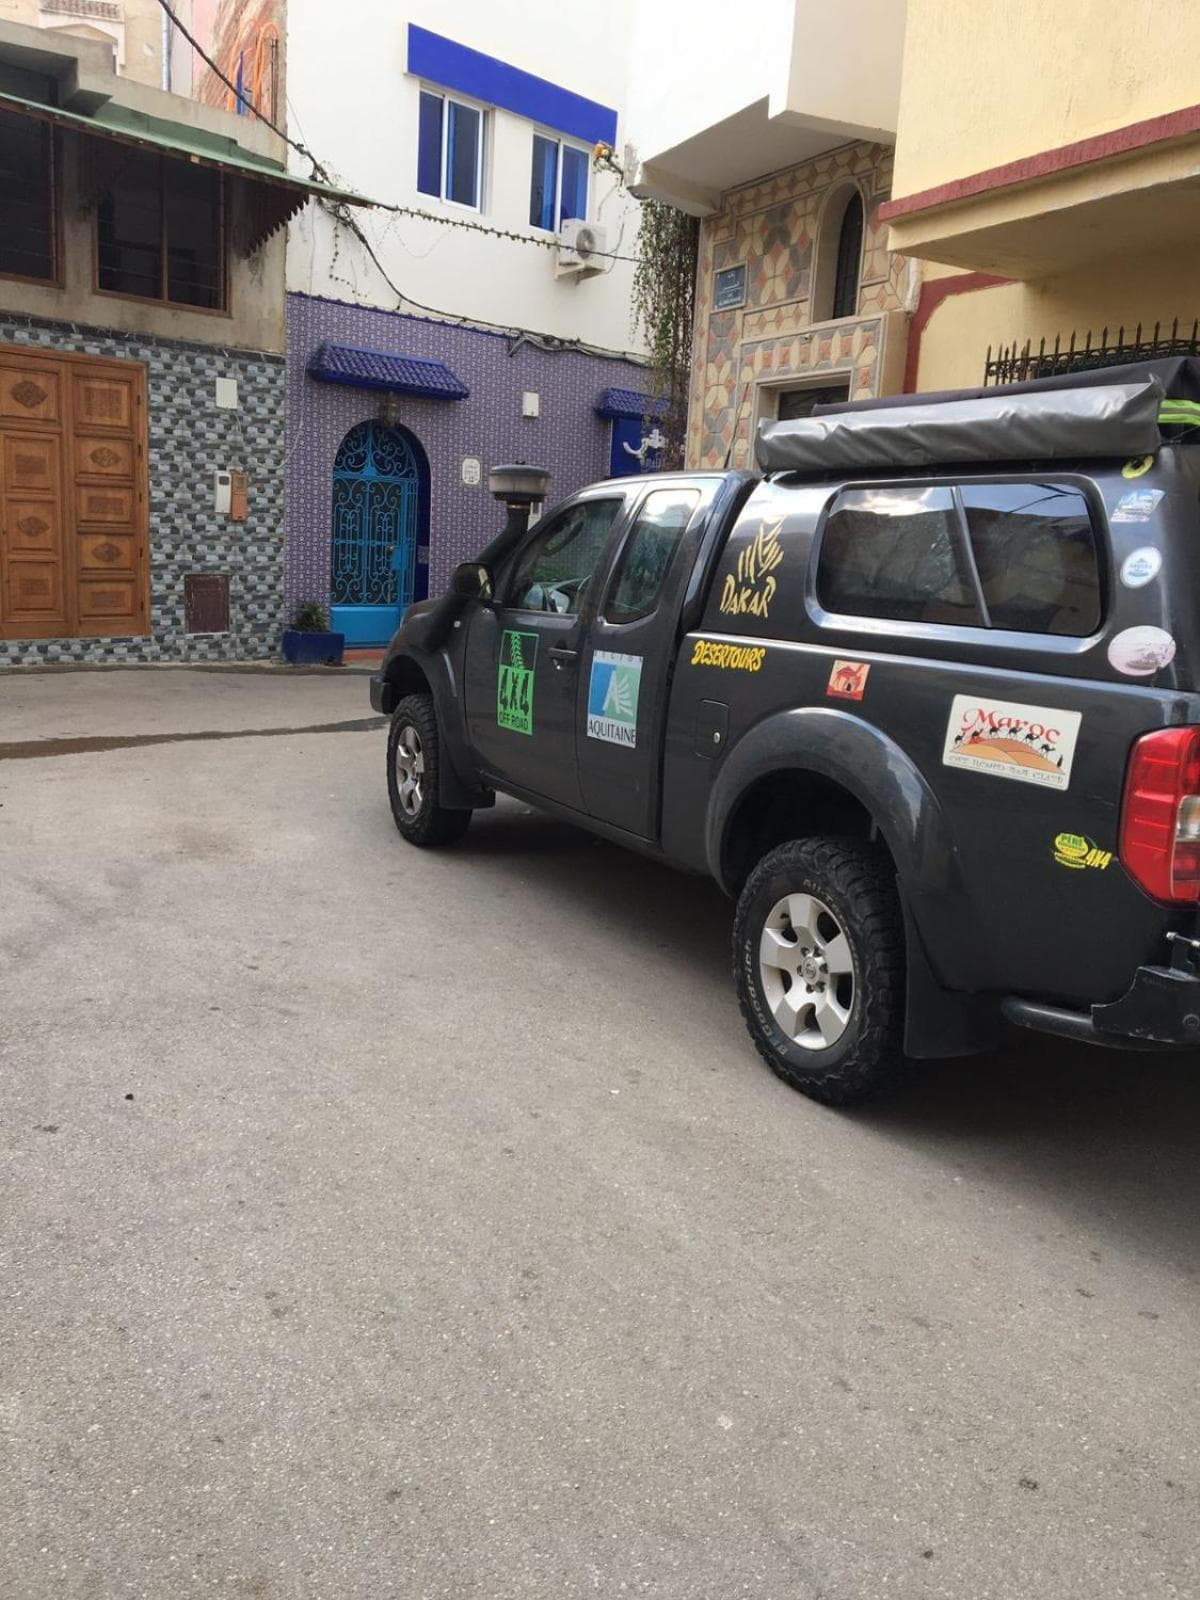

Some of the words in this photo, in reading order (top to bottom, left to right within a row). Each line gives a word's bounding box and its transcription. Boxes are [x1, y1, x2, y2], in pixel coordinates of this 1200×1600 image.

[720, 574, 777, 618] DAKAR
[691, 640, 765, 671] DESERTOURS
[588, 719, 636, 744] AQUITAINE
[961, 708, 1061, 744] Maroc
